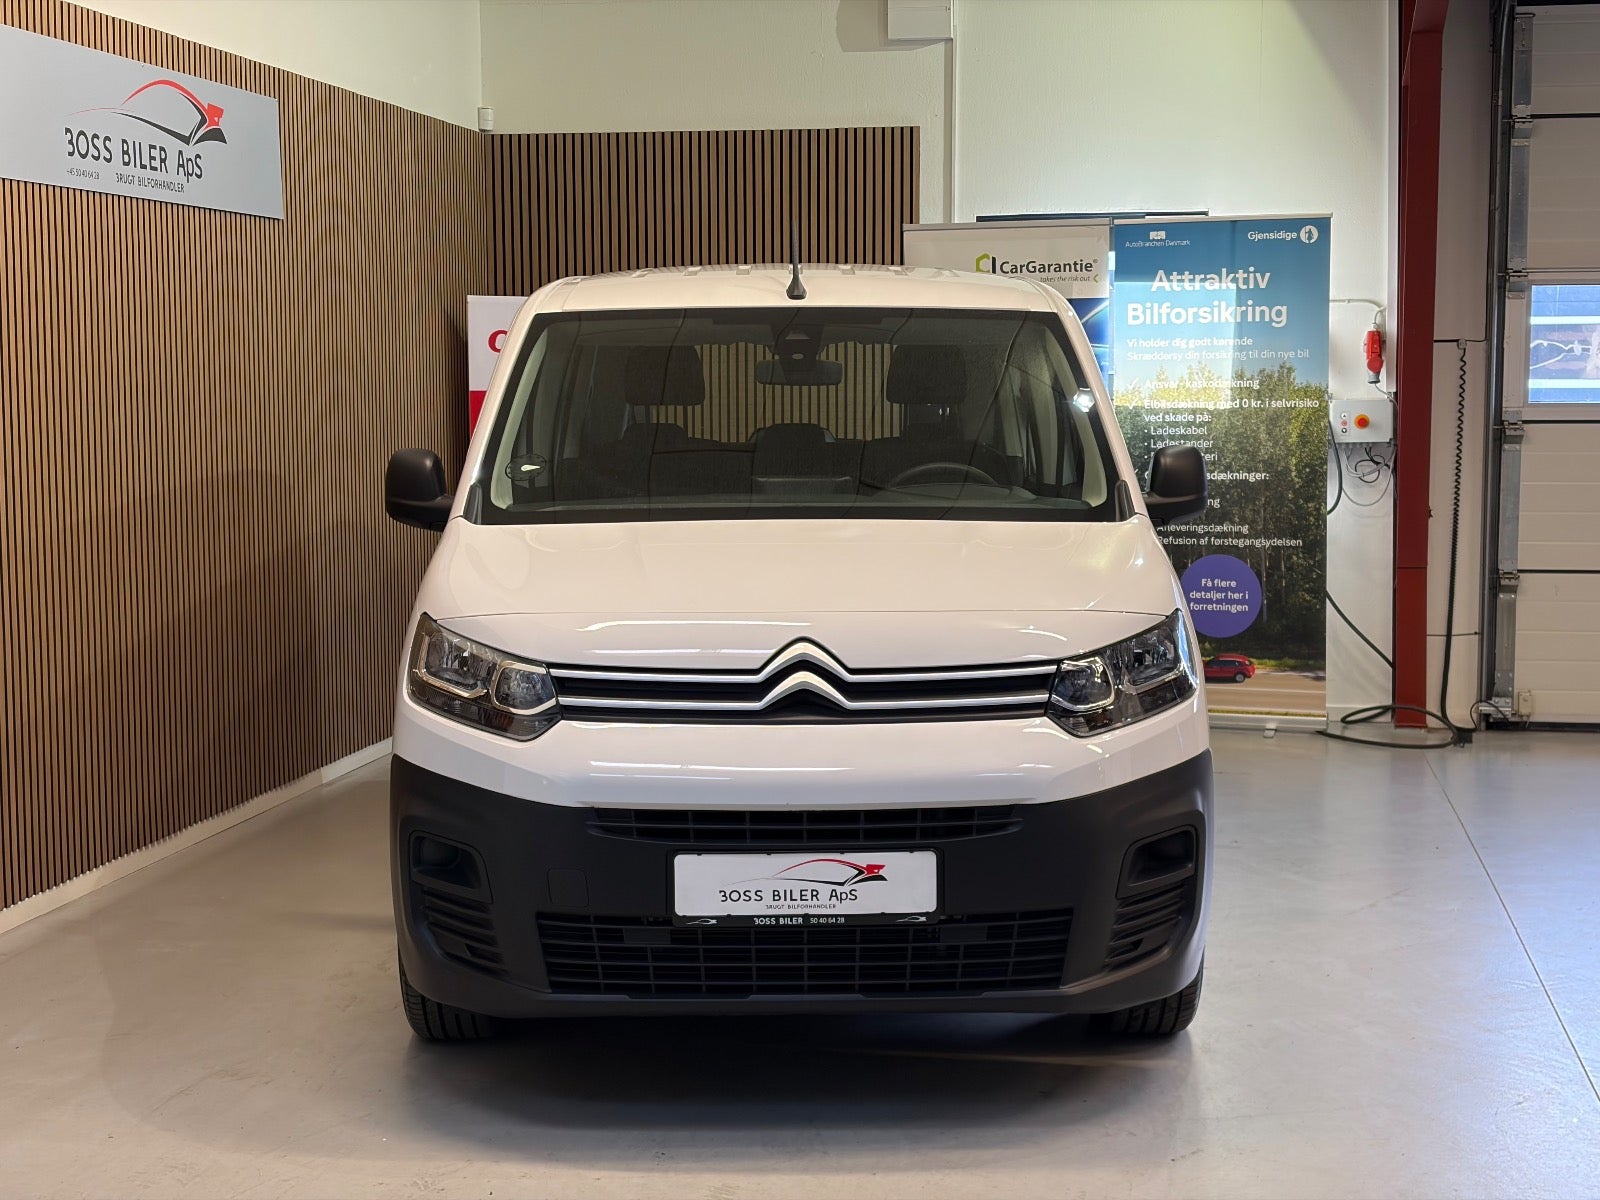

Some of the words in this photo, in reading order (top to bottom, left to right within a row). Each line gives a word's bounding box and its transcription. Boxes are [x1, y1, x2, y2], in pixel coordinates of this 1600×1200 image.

[121, 138, 168, 174] BILER
[176, 150, 203, 183] ApS
[138, 176, 185, 193] BILFORHANDLER
[1247, 230, 1297, 242] Gjensidige
[1165, 239, 1191, 247] Danmark
[1151, 266, 1271, 292] Attraktiv
[1127, 300, 1288, 328] Bilforsikring
[1127, 339, 1137, 348] Vi
[1138, 338, 1169, 347] holder
[1171, 338, 1187, 349] dig
[1188, 338, 1212, 349] godt
[1213, 336, 1253, 347] kørende
[1127, 351, 1183, 361] Skræddersy
[1184, 351, 1200, 360] din
[1202, 351, 1247, 361] forsikring
[1249, 350, 1258, 359] til
[1260, 350, 1276, 359] din
[1278, 351, 1295, 360] nye
[1298, 349, 1310, 359] bil
[1185, 378, 1260, 390] kaskodækning
[1144, 399, 1215, 411] Elbilsdækning
[1216, 399, 1239, 409] med
[1242, 399, 1249, 408] 0
[1251, 399, 1264, 408] kr.
[1266, 399, 1269, 408] i
[1271, 399, 1319, 408] selvrisiko
[1144, 412, 1163, 422] ved
[1164, 412, 1194, 422] skade
[1196, 412, 1212, 424] på:
[1150, 426, 1208, 435] Ladeskabel
[1199, 536, 1209, 545] af
[1210, 537, 1303, 548] førstegangsydelsen
[1201, 577, 1212, 588] Få
[1214, 578, 1237, 588] flere
[1189, 590, 1225, 601] detaljer
[1227, 591, 1244, 600] her
[1245, 591, 1249, 600] i
[1189, 602, 1249, 613] forretningen
[772, 889, 820, 902] BILER
[829, 888, 858, 904] ApS
[780, 917, 803, 925] BILER
